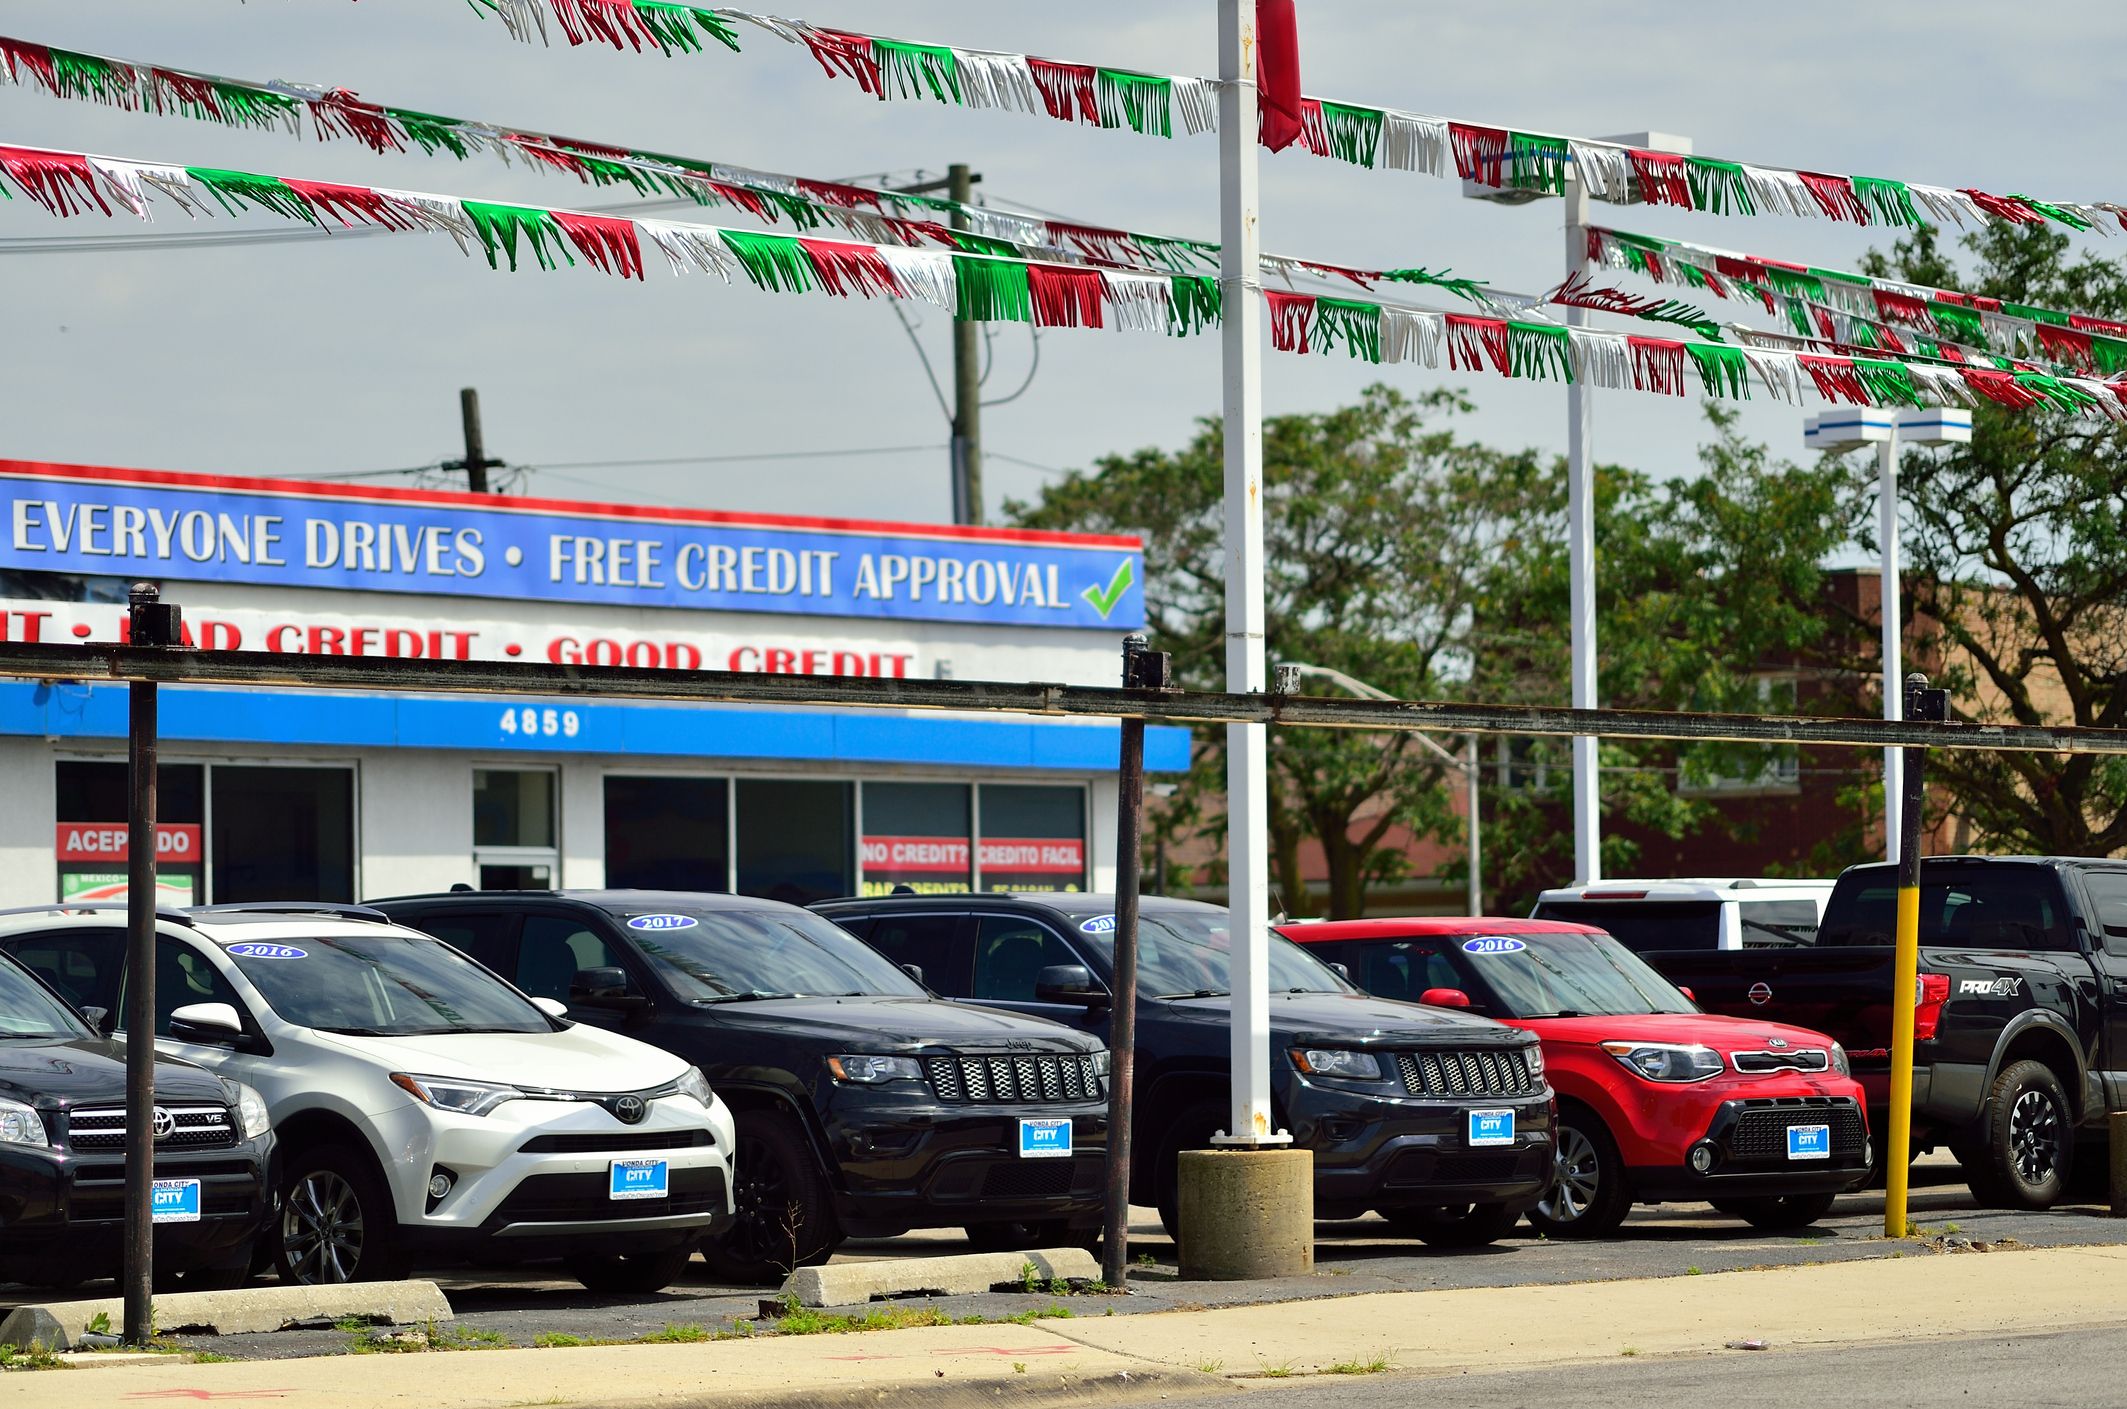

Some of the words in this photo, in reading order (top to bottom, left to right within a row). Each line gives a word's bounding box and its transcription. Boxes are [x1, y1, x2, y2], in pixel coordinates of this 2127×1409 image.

[12, 499, 287, 566] EVERYONE
[305, 518, 486, 577] DRIVES
[550, 534, 666, 588] FREE
[675, 543, 840, 598] CREDIT
[852, 553, 1071, 609] APPROVAL
[500, 708, 580, 737] 4859
[66, 830, 190, 854] ACEPDO
[859, 843, 889, 864] NO
[892, 843, 969, 865] CREDIT?
[977, 844, 1039, 865] CREDITO
[1041, 845, 1081, 867] FACIL
[641, 916, 684, 929] 2017
[1090, 917, 1116, 931] 201
[241, 945, 293, 957] 2016
[1474, 939, 1515, 952] 2016
[1005, 1038, 1032, 1051] Jeep
[205, 1114, 222, 1123] V6
[1480, 1119, 1502, 1130] CITY
[1033, 1129, 1058, 1141] CITY
[1798, 1135, 1818, 1145] CITY
[626, 1169, 653, 1181] CITY
[155, 1192, 183, 1204] CITY
